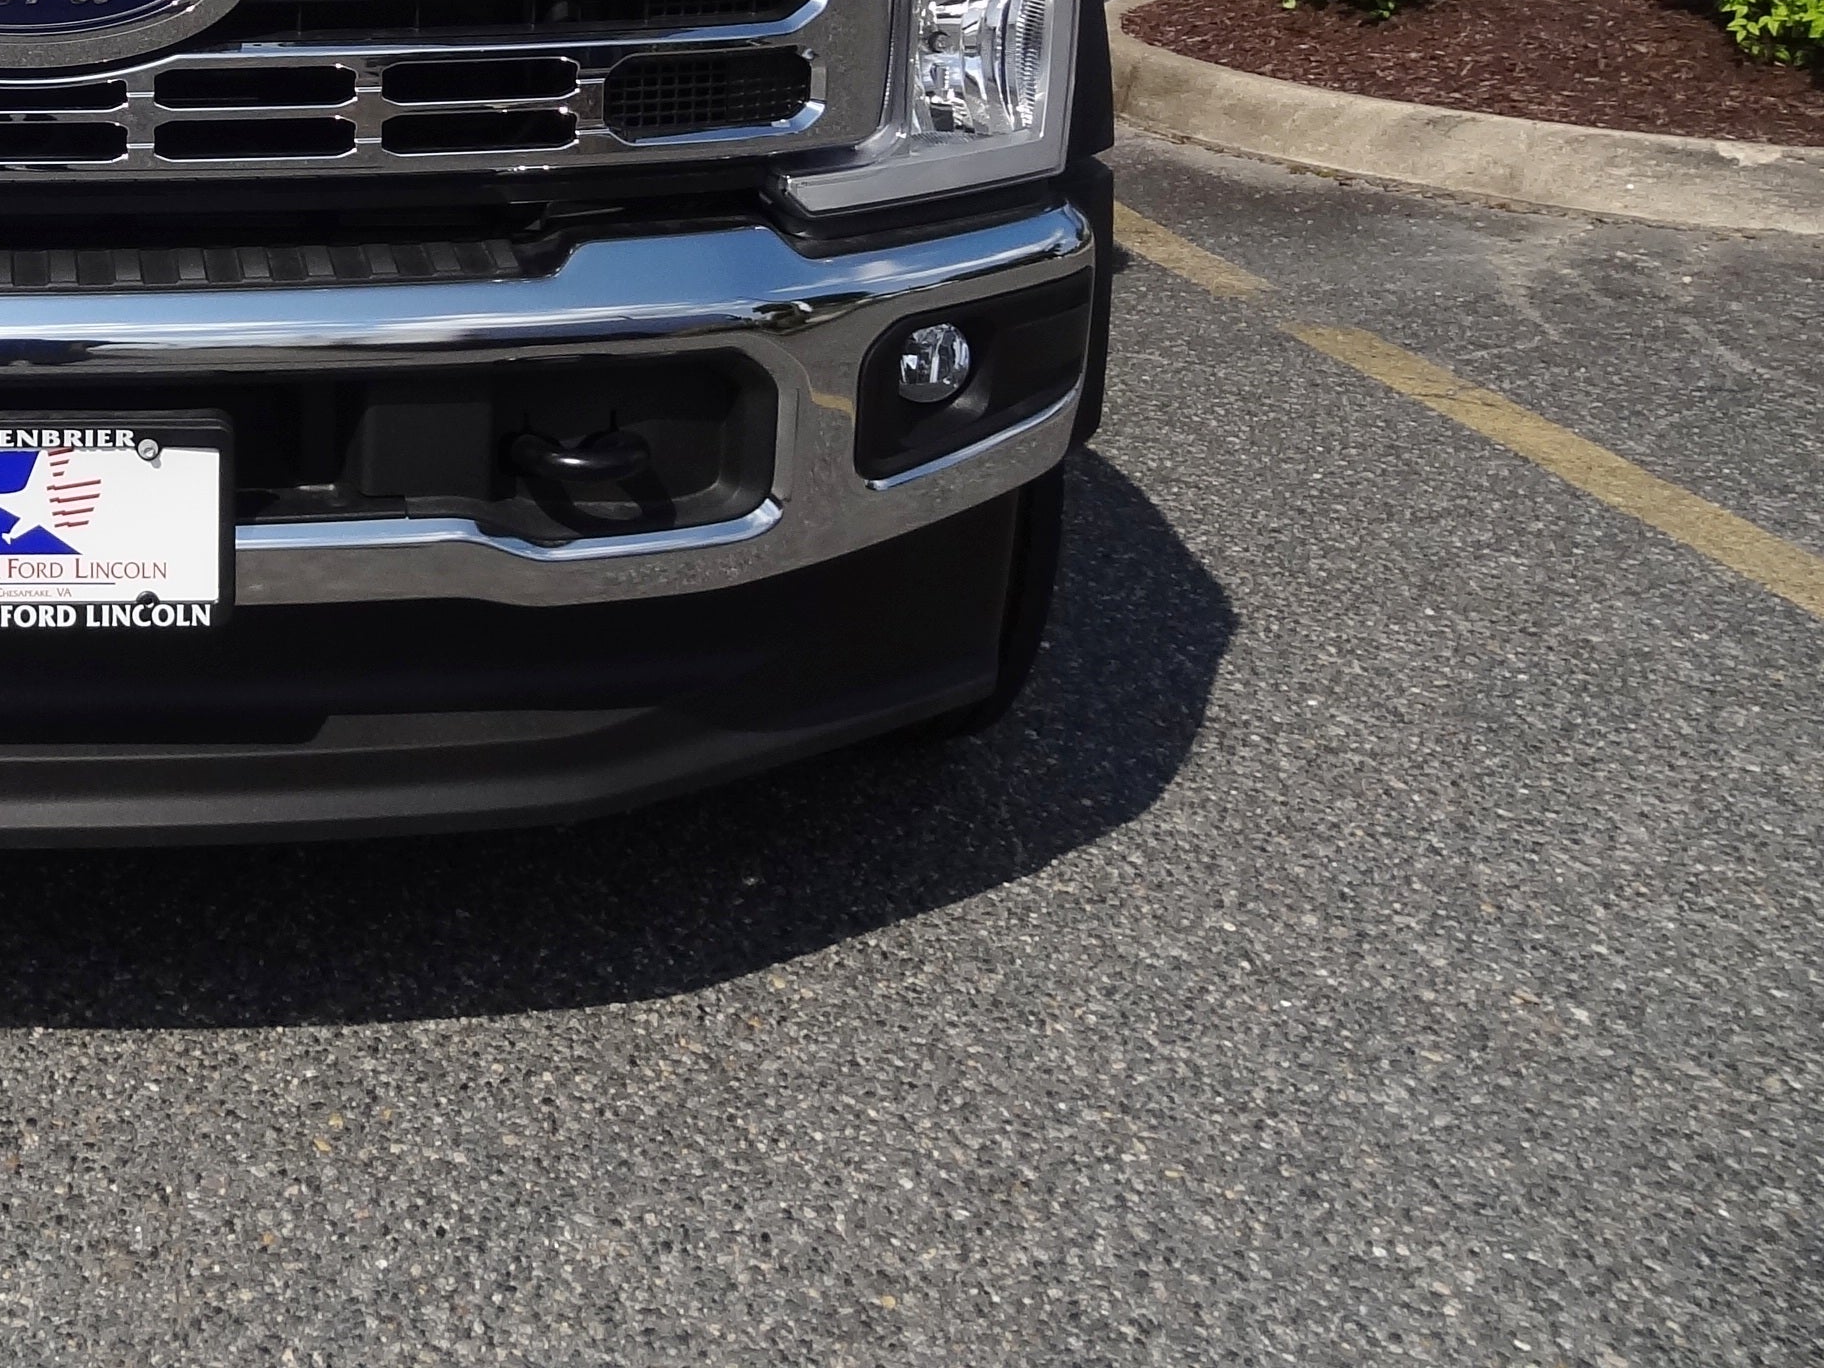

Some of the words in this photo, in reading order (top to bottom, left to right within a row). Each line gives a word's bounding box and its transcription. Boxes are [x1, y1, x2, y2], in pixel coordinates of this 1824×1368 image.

[7, 558, 64, 580] FORD
[75, 558, 168, 580] LINCOLN
[56, 587, 72, 597] VA
[0, 604, 77, 628] FORD
[86, 603, 211, 628] LINCOLN
